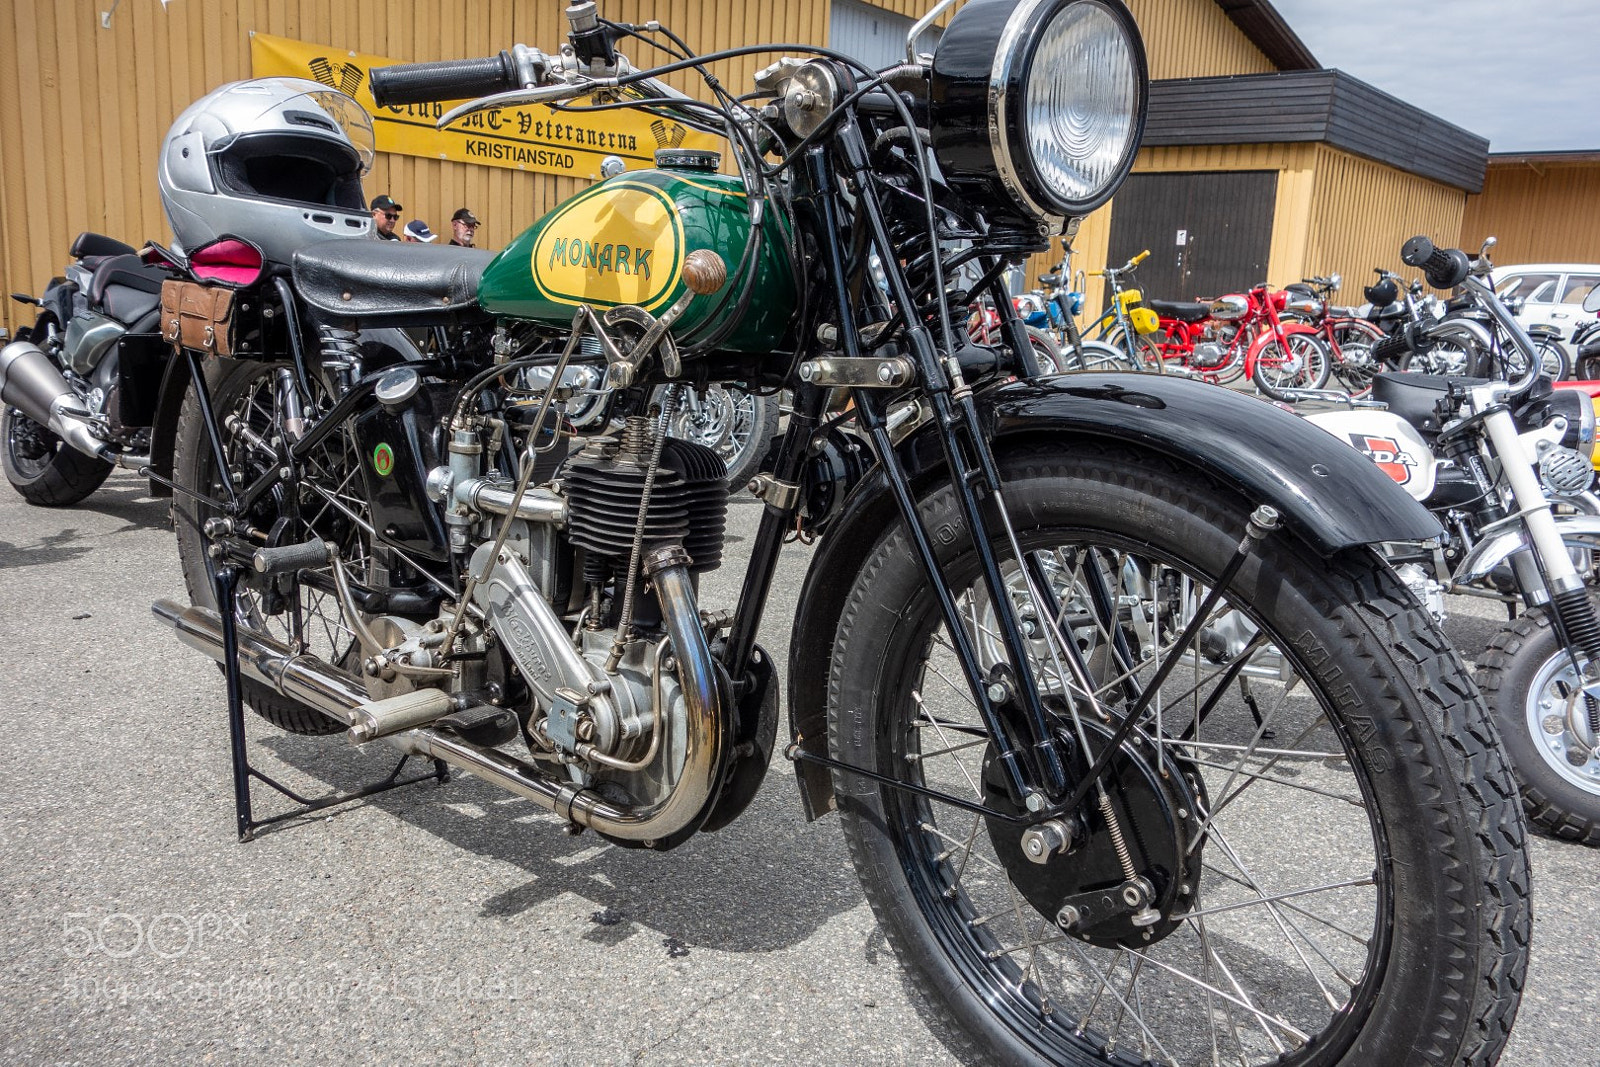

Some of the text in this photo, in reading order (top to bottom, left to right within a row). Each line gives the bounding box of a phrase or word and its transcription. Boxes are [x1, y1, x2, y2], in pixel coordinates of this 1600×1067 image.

[465, 139, 574, 169] KRISTIANSTAD
[549, 237, 653, 281] MONARK
[1294, 629, 1394, 774] MITAS
